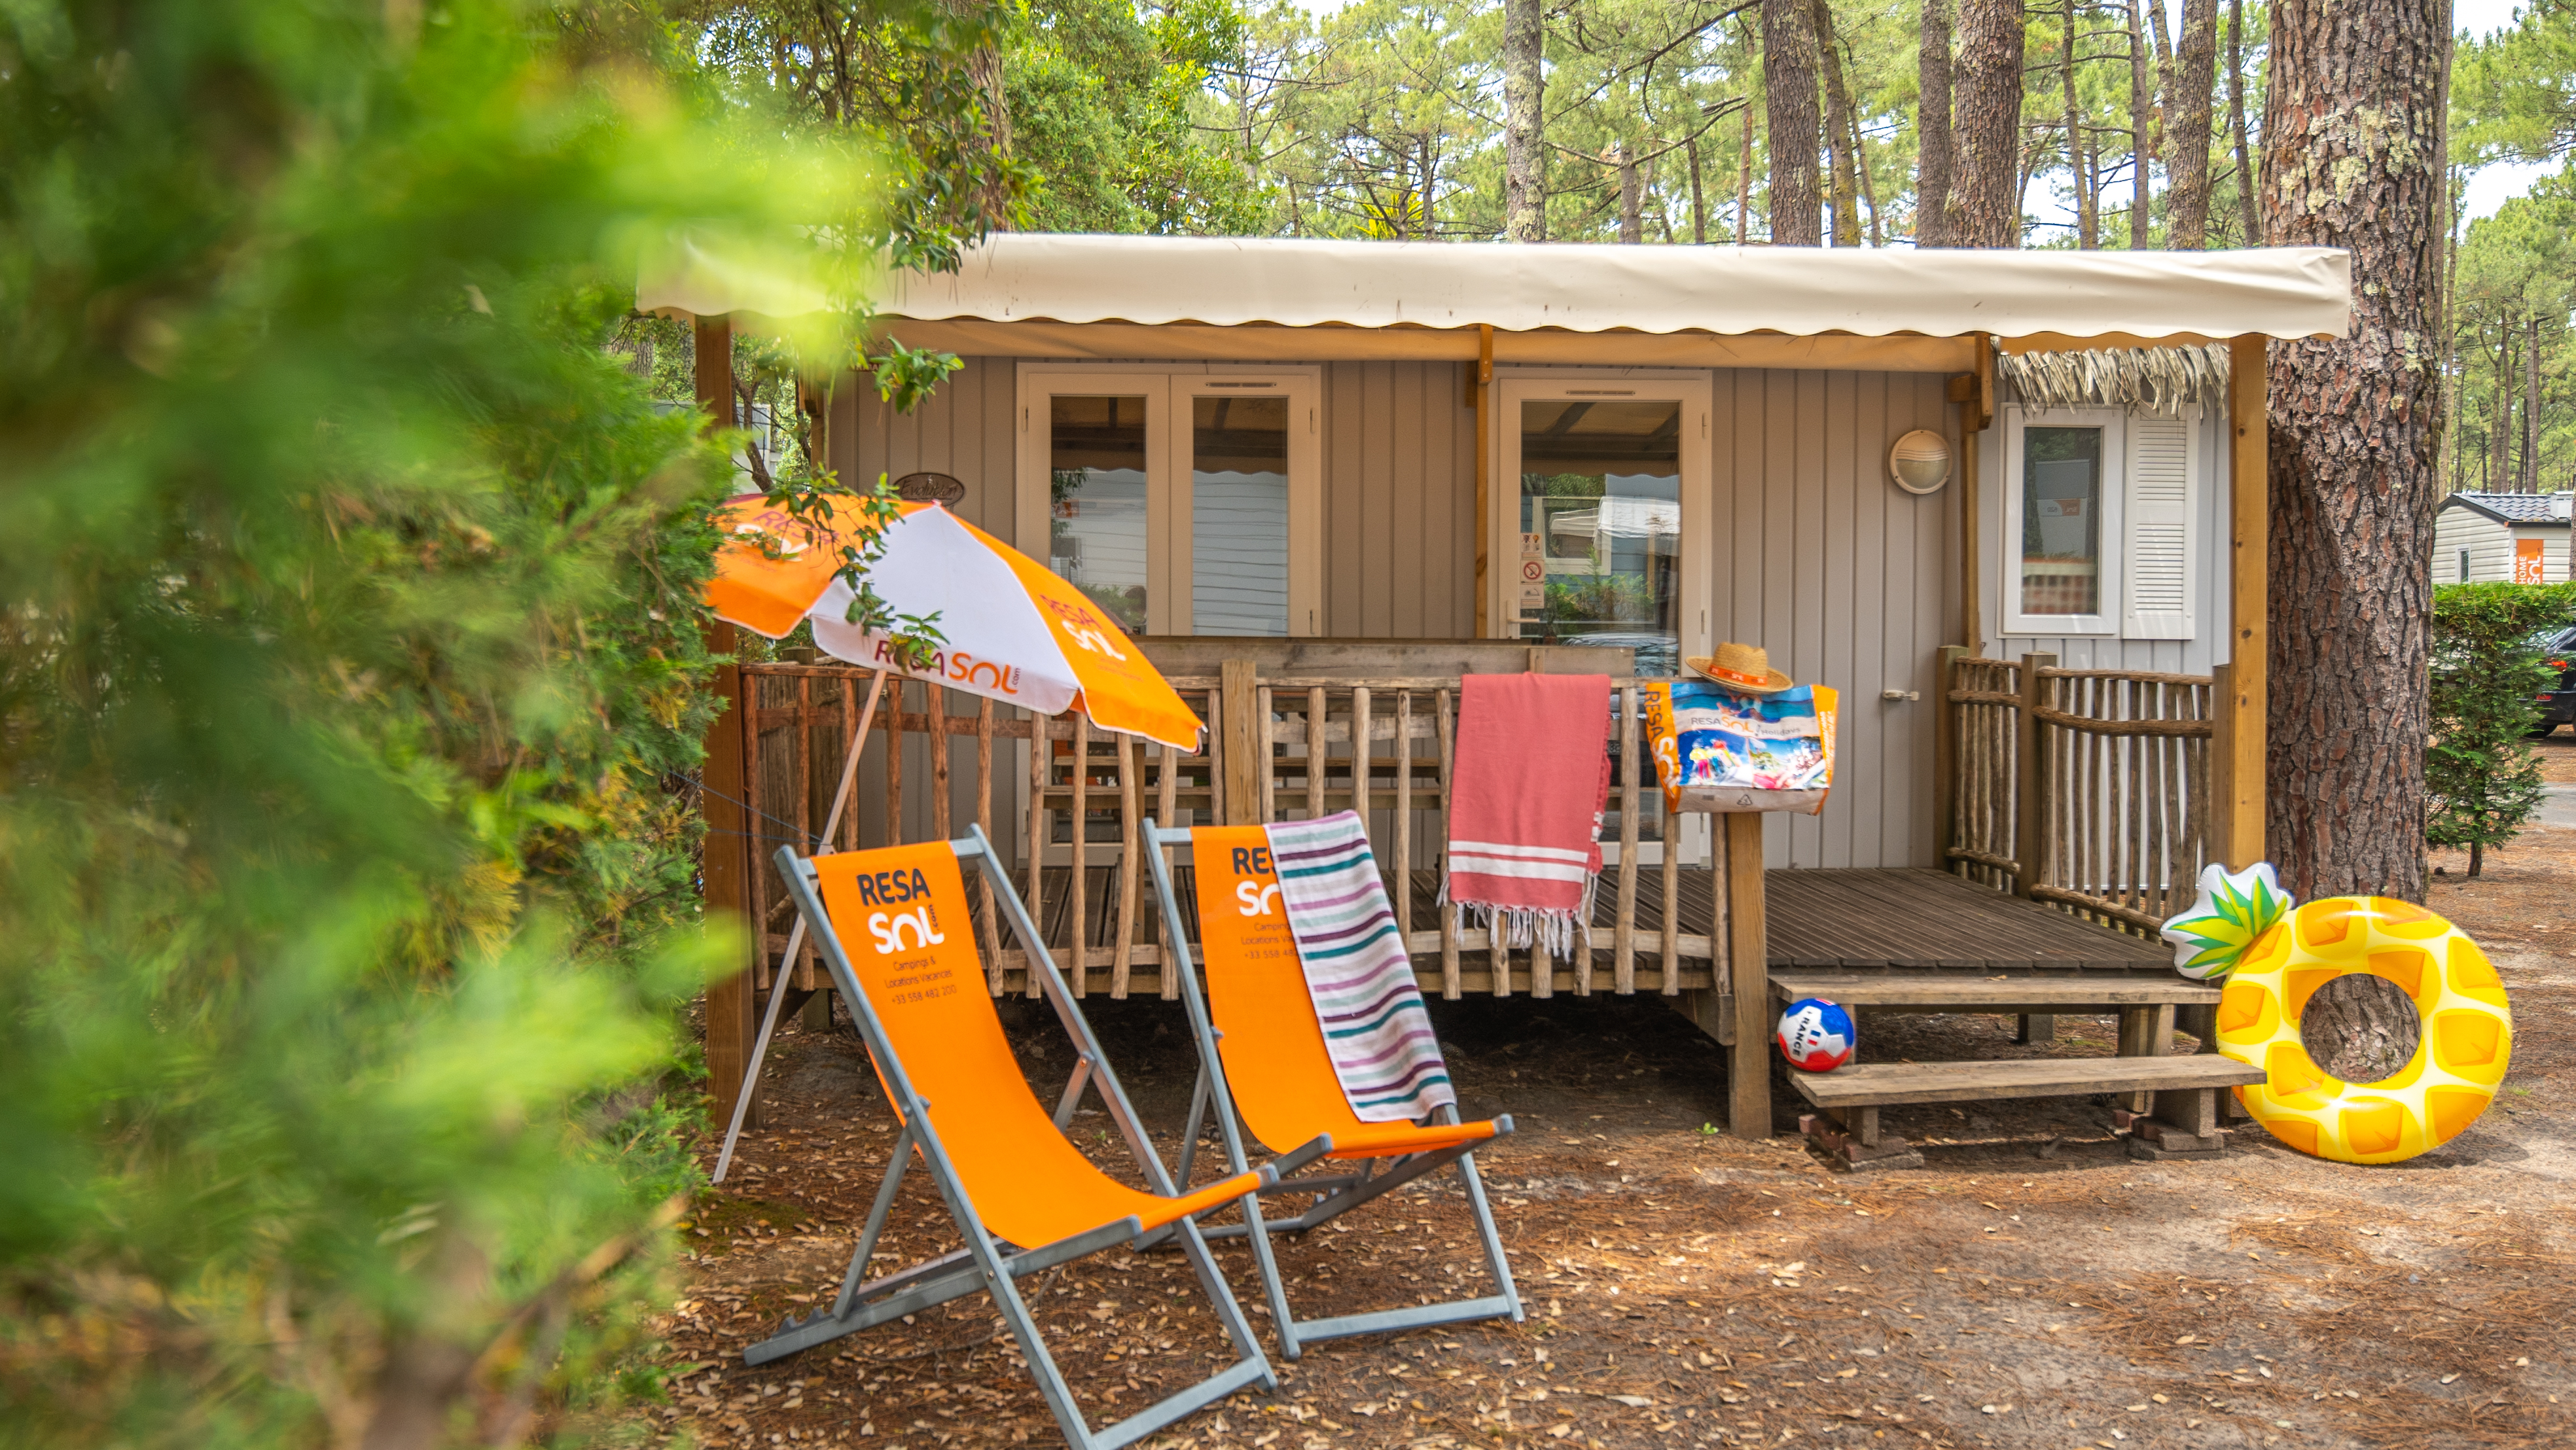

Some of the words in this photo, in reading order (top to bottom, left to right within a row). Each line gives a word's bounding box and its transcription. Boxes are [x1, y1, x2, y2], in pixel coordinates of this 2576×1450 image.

[2518, 556, 2527, 584] HOME
[2527, 556, 2541, 586] SOL
[1039, 594, 1103, 631] RESA
[1232, 847, 1278, 875] RE
[856, 868, 931, 907] RESA
[1236, 880, 1281, 917] SO
[868, 906, 945, 955] SOL
[893, 959, 929, 972] Campings
[930, 955, 937, 965] &
[884, 976, 920, 989] Locations
[919, 970, 953, 982] Vacances
[892, 995, 906, 1005] +33
